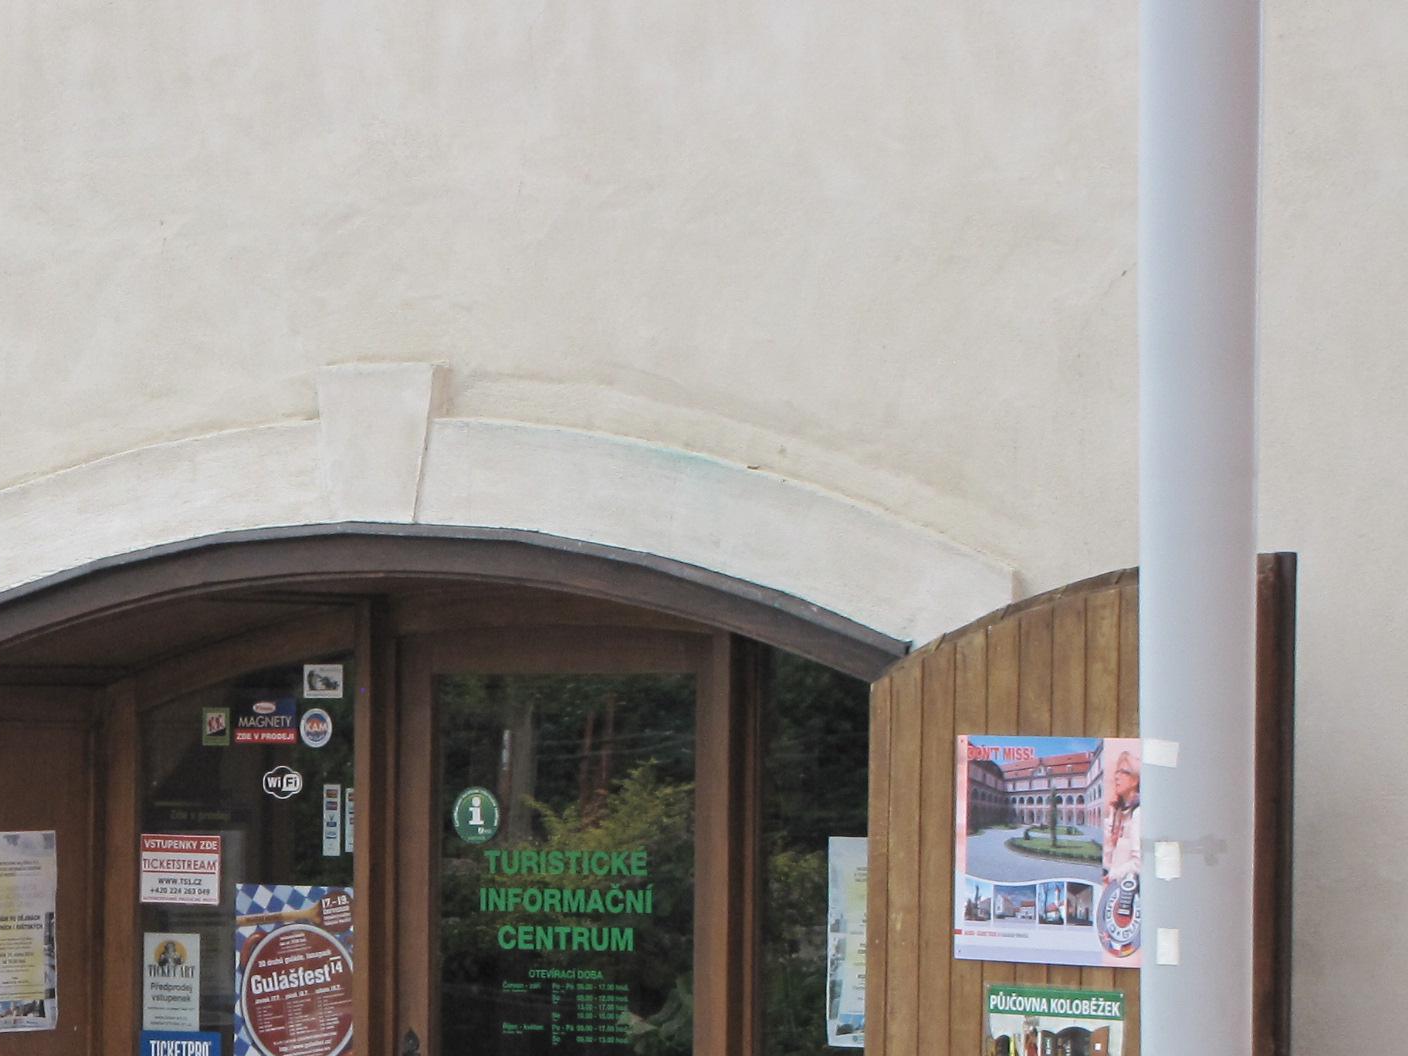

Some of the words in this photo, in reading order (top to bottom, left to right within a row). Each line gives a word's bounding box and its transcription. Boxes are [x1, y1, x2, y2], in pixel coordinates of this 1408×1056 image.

[239, 716, 292, 727] MAGNETY
[1003, 746, 1035, 761] MISS!
[144, 839, 198, 850] VSTUPENKY
[200, 840, 218, 850] ZDE
[143, 858, 216, 871] TICKETSTREAM
[484, 846, 648, 876] TURISTICKÉ
[479, 883, 654, 914] INFORMAČNÍ
[497, 925, 635, 951] CENTRUM
[251, 964, 331, 995] Gulášfest
[989, 991, 1049, 1013] PŮJČOVNA
[1050, 998, 1121, 1017] KOLOBĚŽEK
